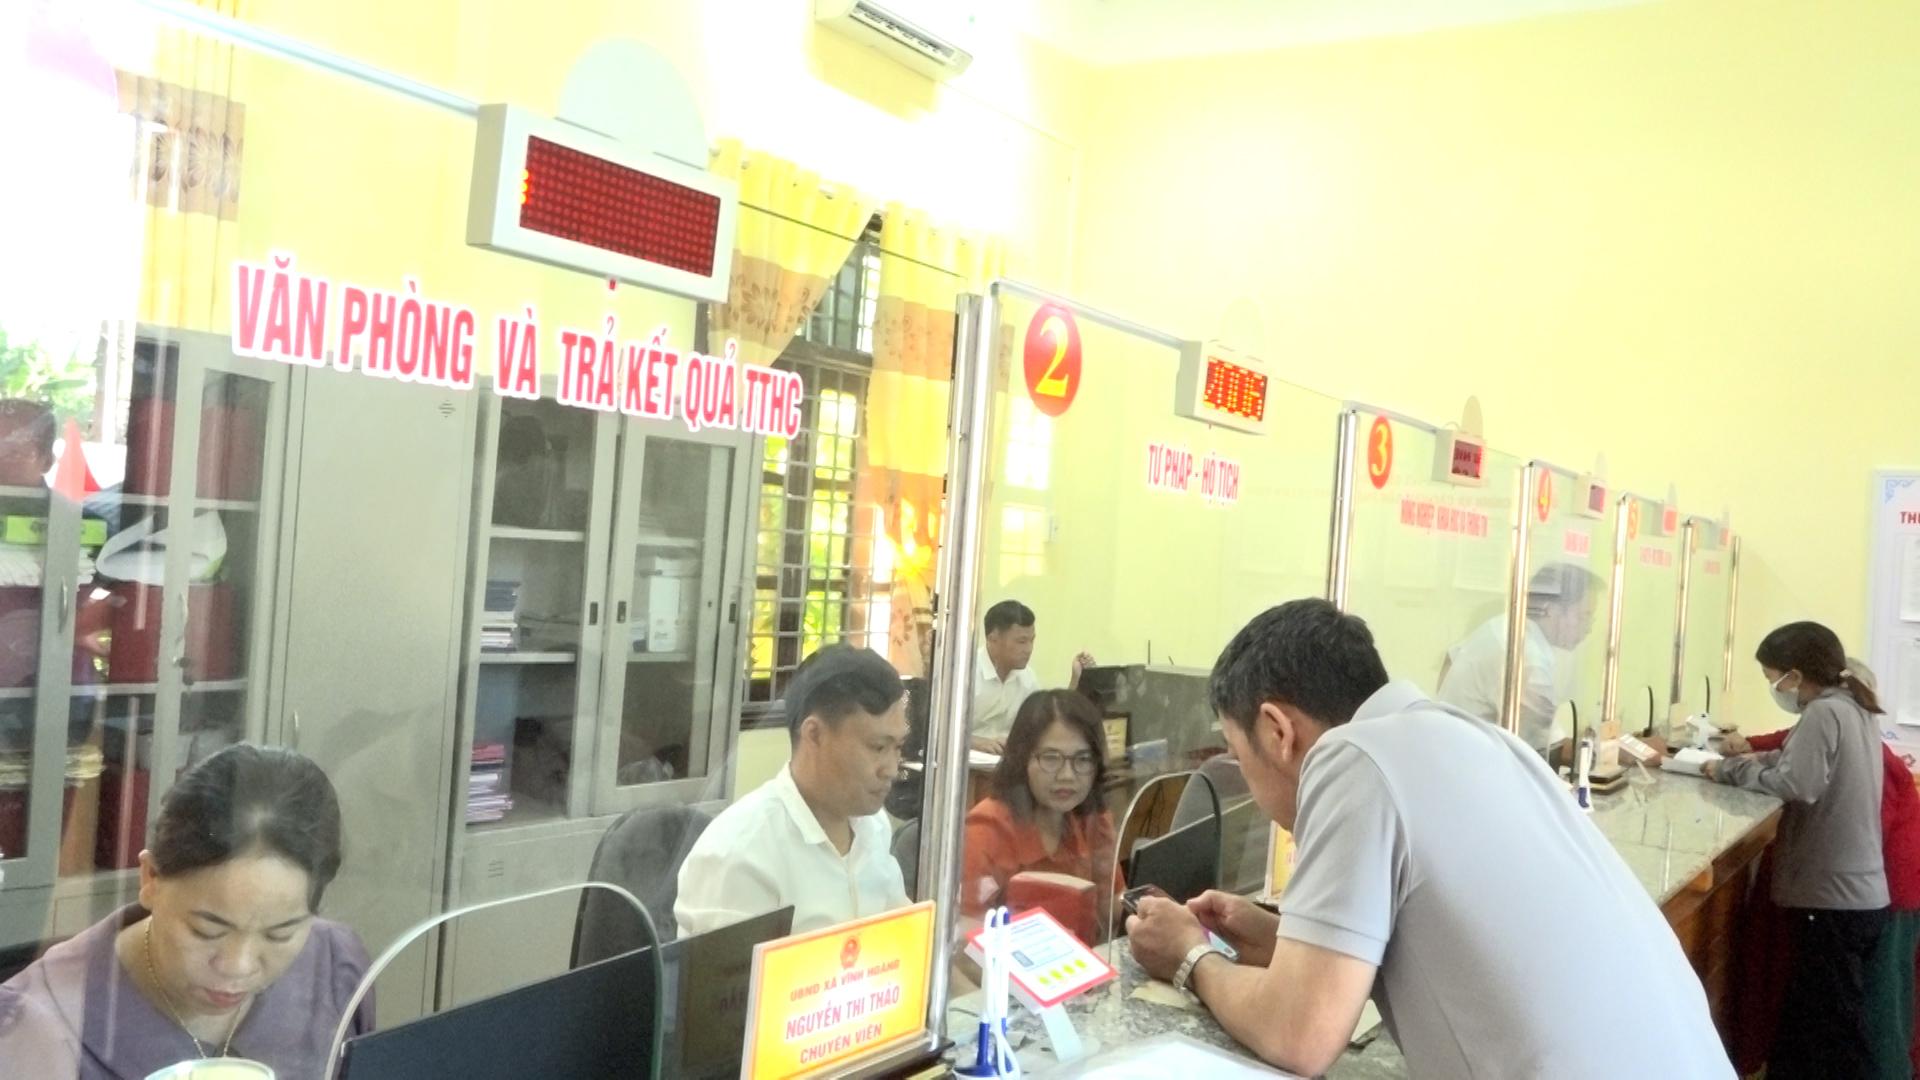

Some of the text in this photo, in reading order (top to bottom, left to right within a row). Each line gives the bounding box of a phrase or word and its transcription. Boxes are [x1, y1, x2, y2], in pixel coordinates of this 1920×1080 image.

[237, 255, 802, 437] VĂN PHÒNG VÀ TRẢ KẾT QUẢ TTHC
[1034, 315, 1069, 399] 2
[1203, 357, 1264, 421] 2006
[1371, 422, 1389, 477] 3
[789, 983, 820, 1002] UBND
